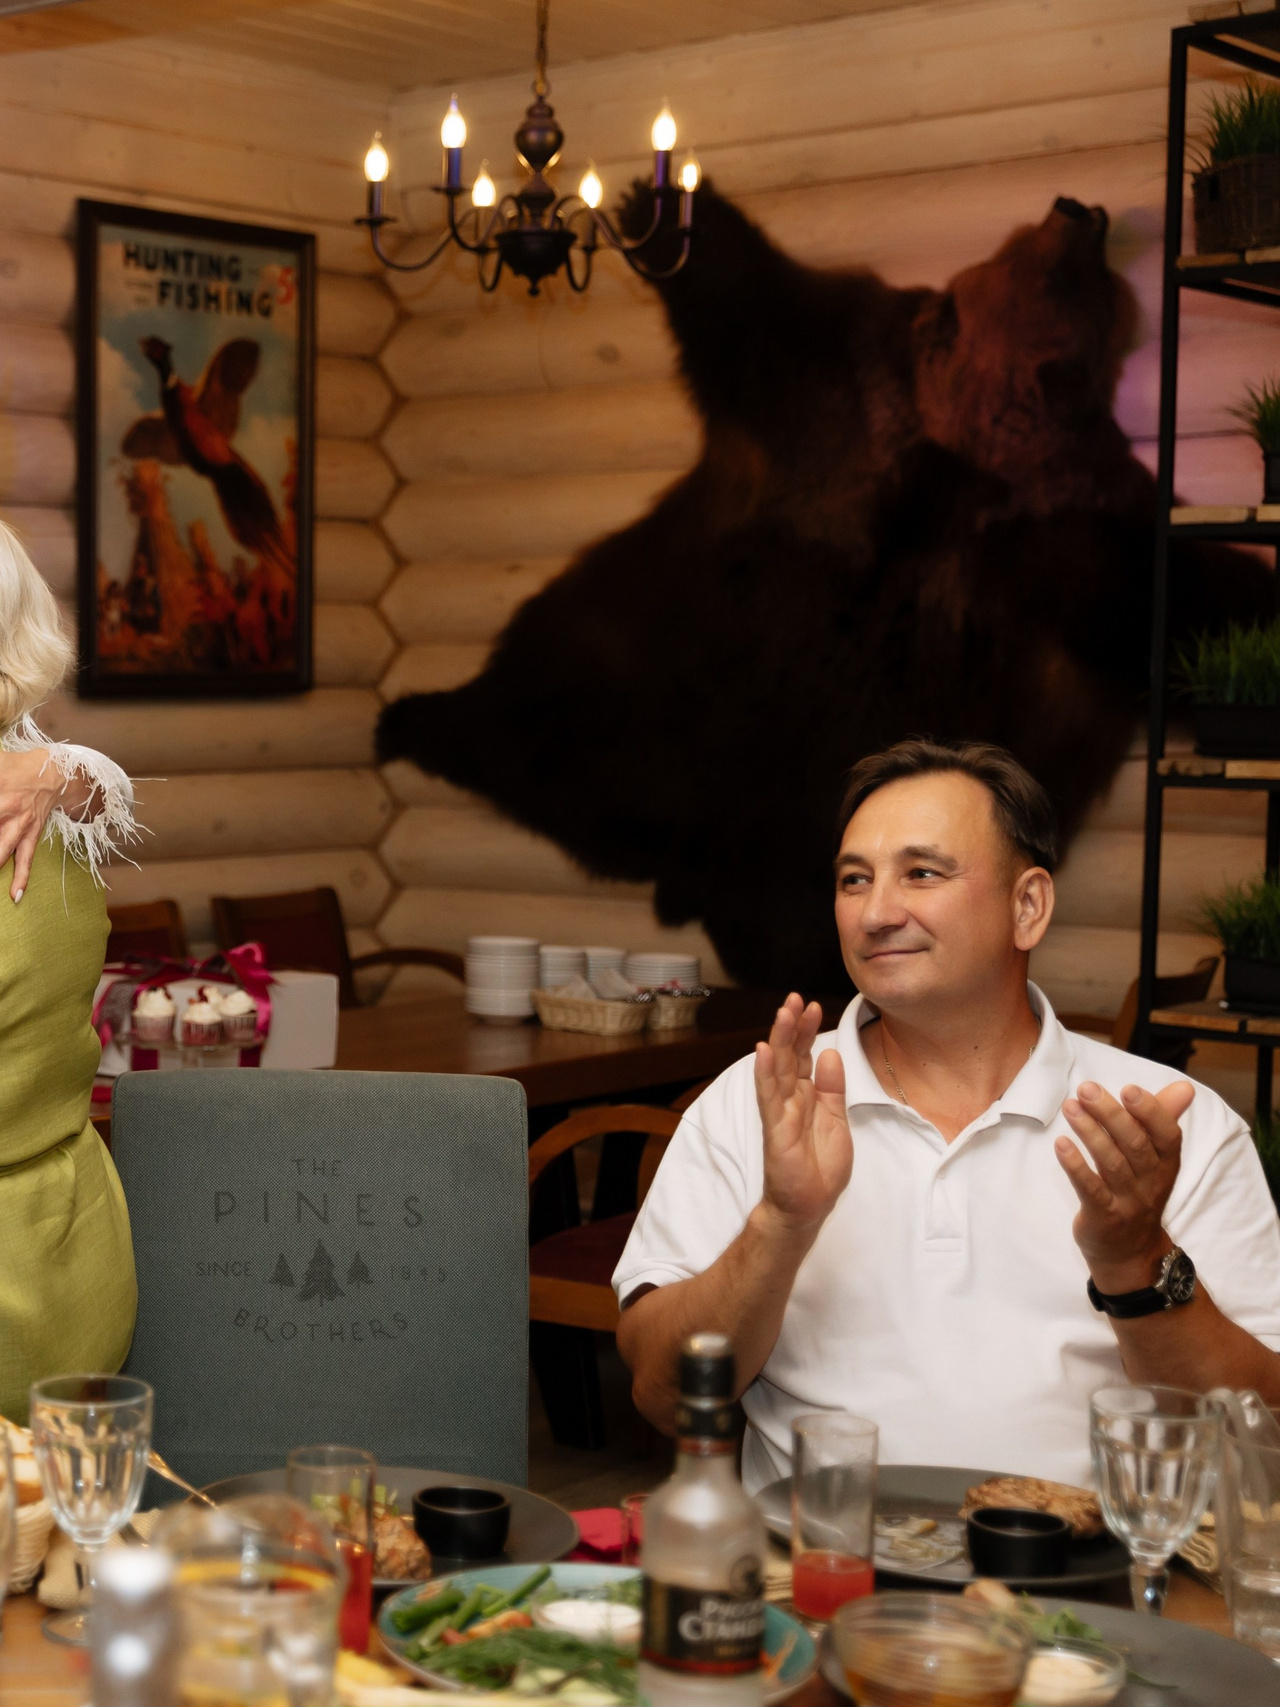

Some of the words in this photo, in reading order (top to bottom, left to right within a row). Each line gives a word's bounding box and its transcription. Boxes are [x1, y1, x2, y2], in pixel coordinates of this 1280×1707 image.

[123, 242, 243, 282] HUNTING
[157, 280, 274, 318] FISHING
[291, 1158, 342, 1178] THE
[214, 1190, 424, 1229] PINES
[196, 1260, 253, 1278] SINCE
[233, 1308, 409, 1345] BROTHERS
